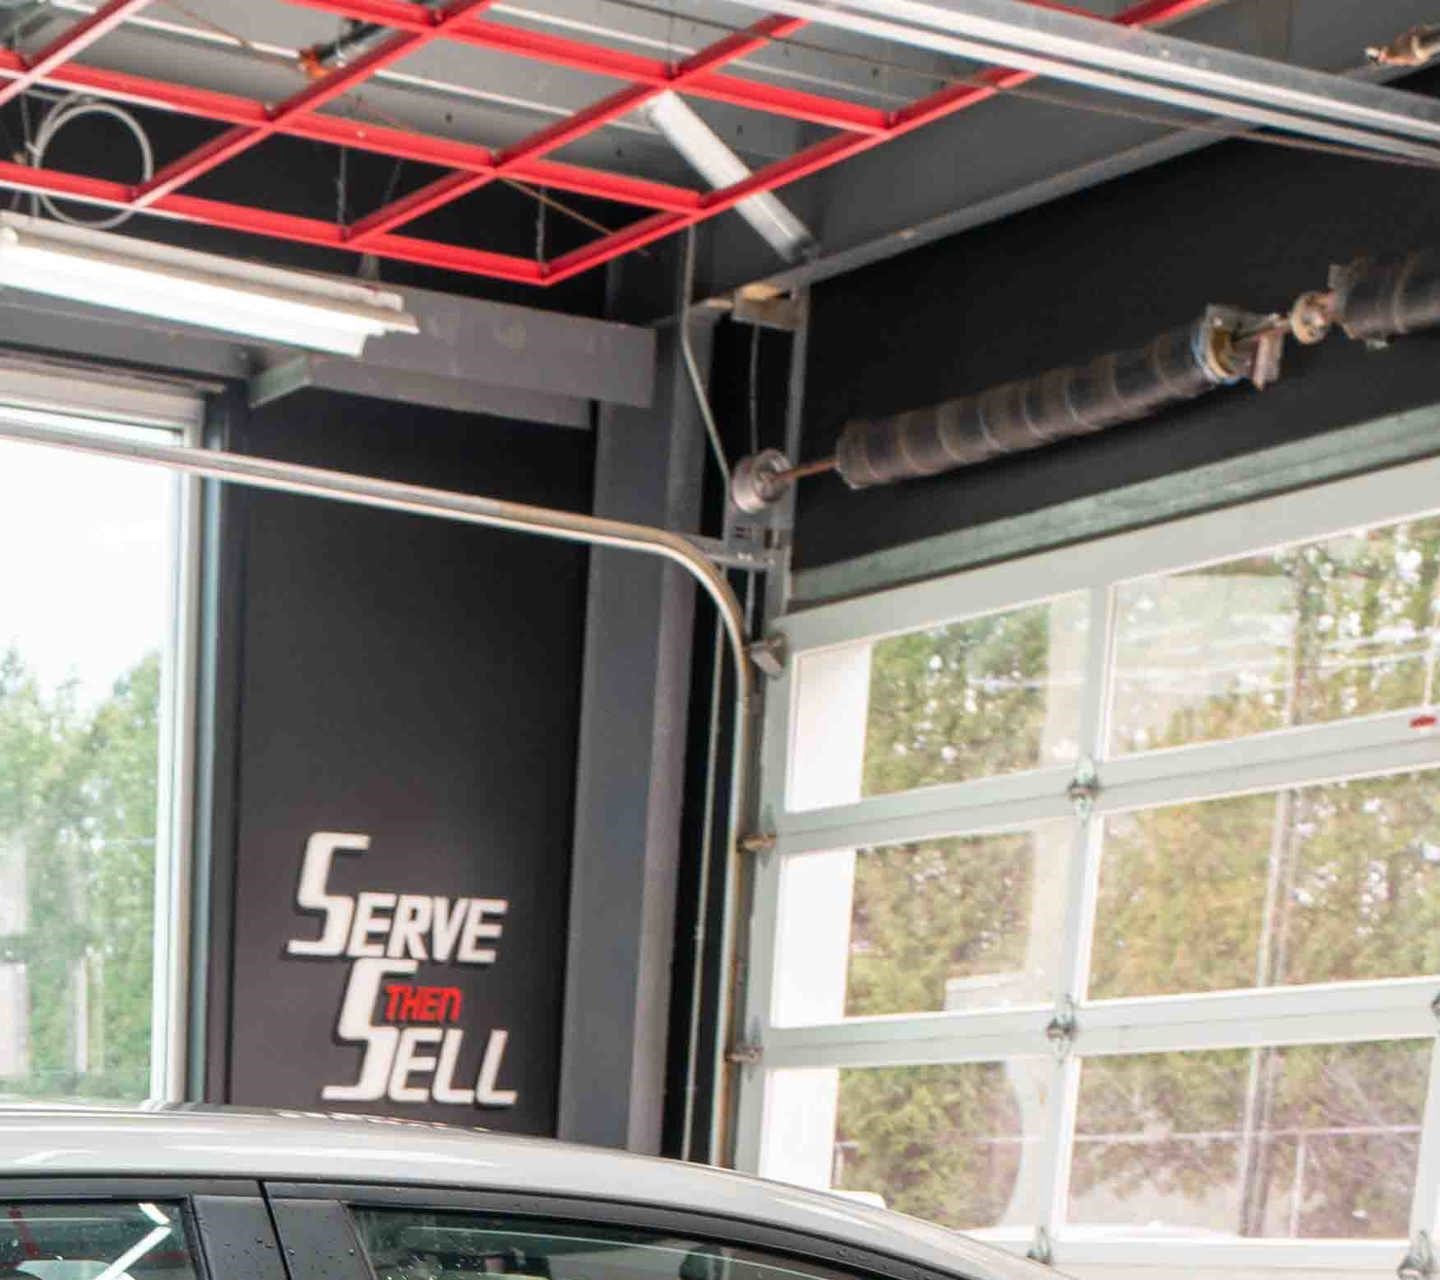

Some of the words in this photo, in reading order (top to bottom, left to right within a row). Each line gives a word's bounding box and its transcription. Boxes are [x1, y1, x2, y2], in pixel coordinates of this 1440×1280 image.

[287, 832, 508, 963] SERVE
[321, 958, 517, 1105] SELL
[385, 984, 463, 1022] THEN
